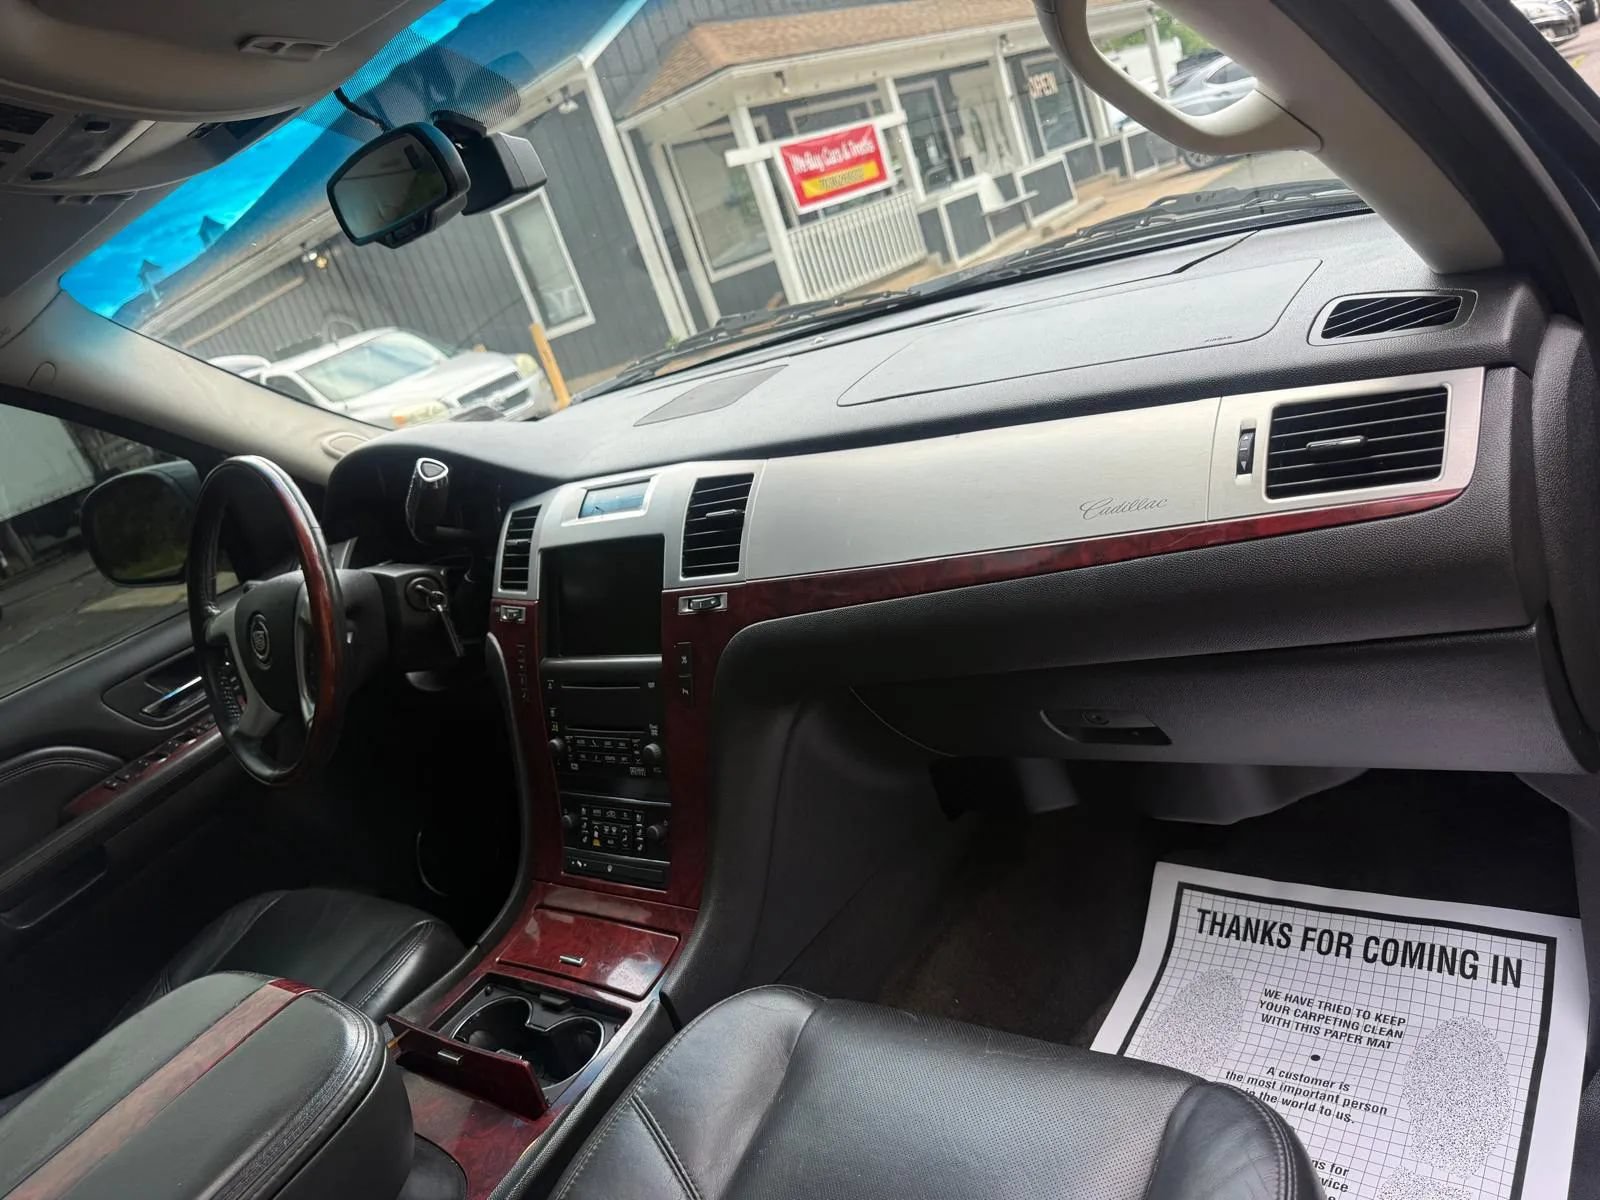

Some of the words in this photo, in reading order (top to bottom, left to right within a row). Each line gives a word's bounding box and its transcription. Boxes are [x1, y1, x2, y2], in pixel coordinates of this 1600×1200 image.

[1079, 496, 1168, 520] Cadillac
[1197, 908, 1293, 949] THANKS
[1300, 926, 1354, 959] FOR
[1363, 935, 1480, 981] COMING
[1491, 954, 1523, 989] IN
[1259, 999, 1291, 1016] YOUR
[1293, 1008, 1360, 1031] CARPETING
[1363, 1023, 1404, 1038] CLEAN
[1264, 988, 1283, 1000] WE
[1284, 993, 1314, 1008] HAVE
[1317, 1000, 1352, 1016] TRIED
[1355, 1008, 1371, 1020] TO
[1374, 1012, 1406, 1027] KEEP
[1261, 1013, 1291, 1028] WITH
[1294, 1022, 1321, 1036] THIS
[1323, 1028, 1362, 1045] PAPER
[1366, 1037, 1394, 1049] MAT
[1225, 1070, 1244, 1082] the
[1247, 1075, 1277, 1089] most
[1279, 1082, 1340, 1104] important
[1342, 1097, 1388, 1115] person
[1266, 1066, 1275, 1076] A
[1278, 1069, 1335, 1089] customer
[1338, 1082, 1350, 1092] is
[1244, 1087, 1256, 1097] in
[1259, 1091, 1278, 1103] the
[1281, 1097, 1317, 1112] world
[1319, 1106, 1332, 1117] to
[1335, 1111, 1355, 1123] us.
[1320, 1177, 1349, 1193] vice
[1329, 1163, 1350, 1176] for
